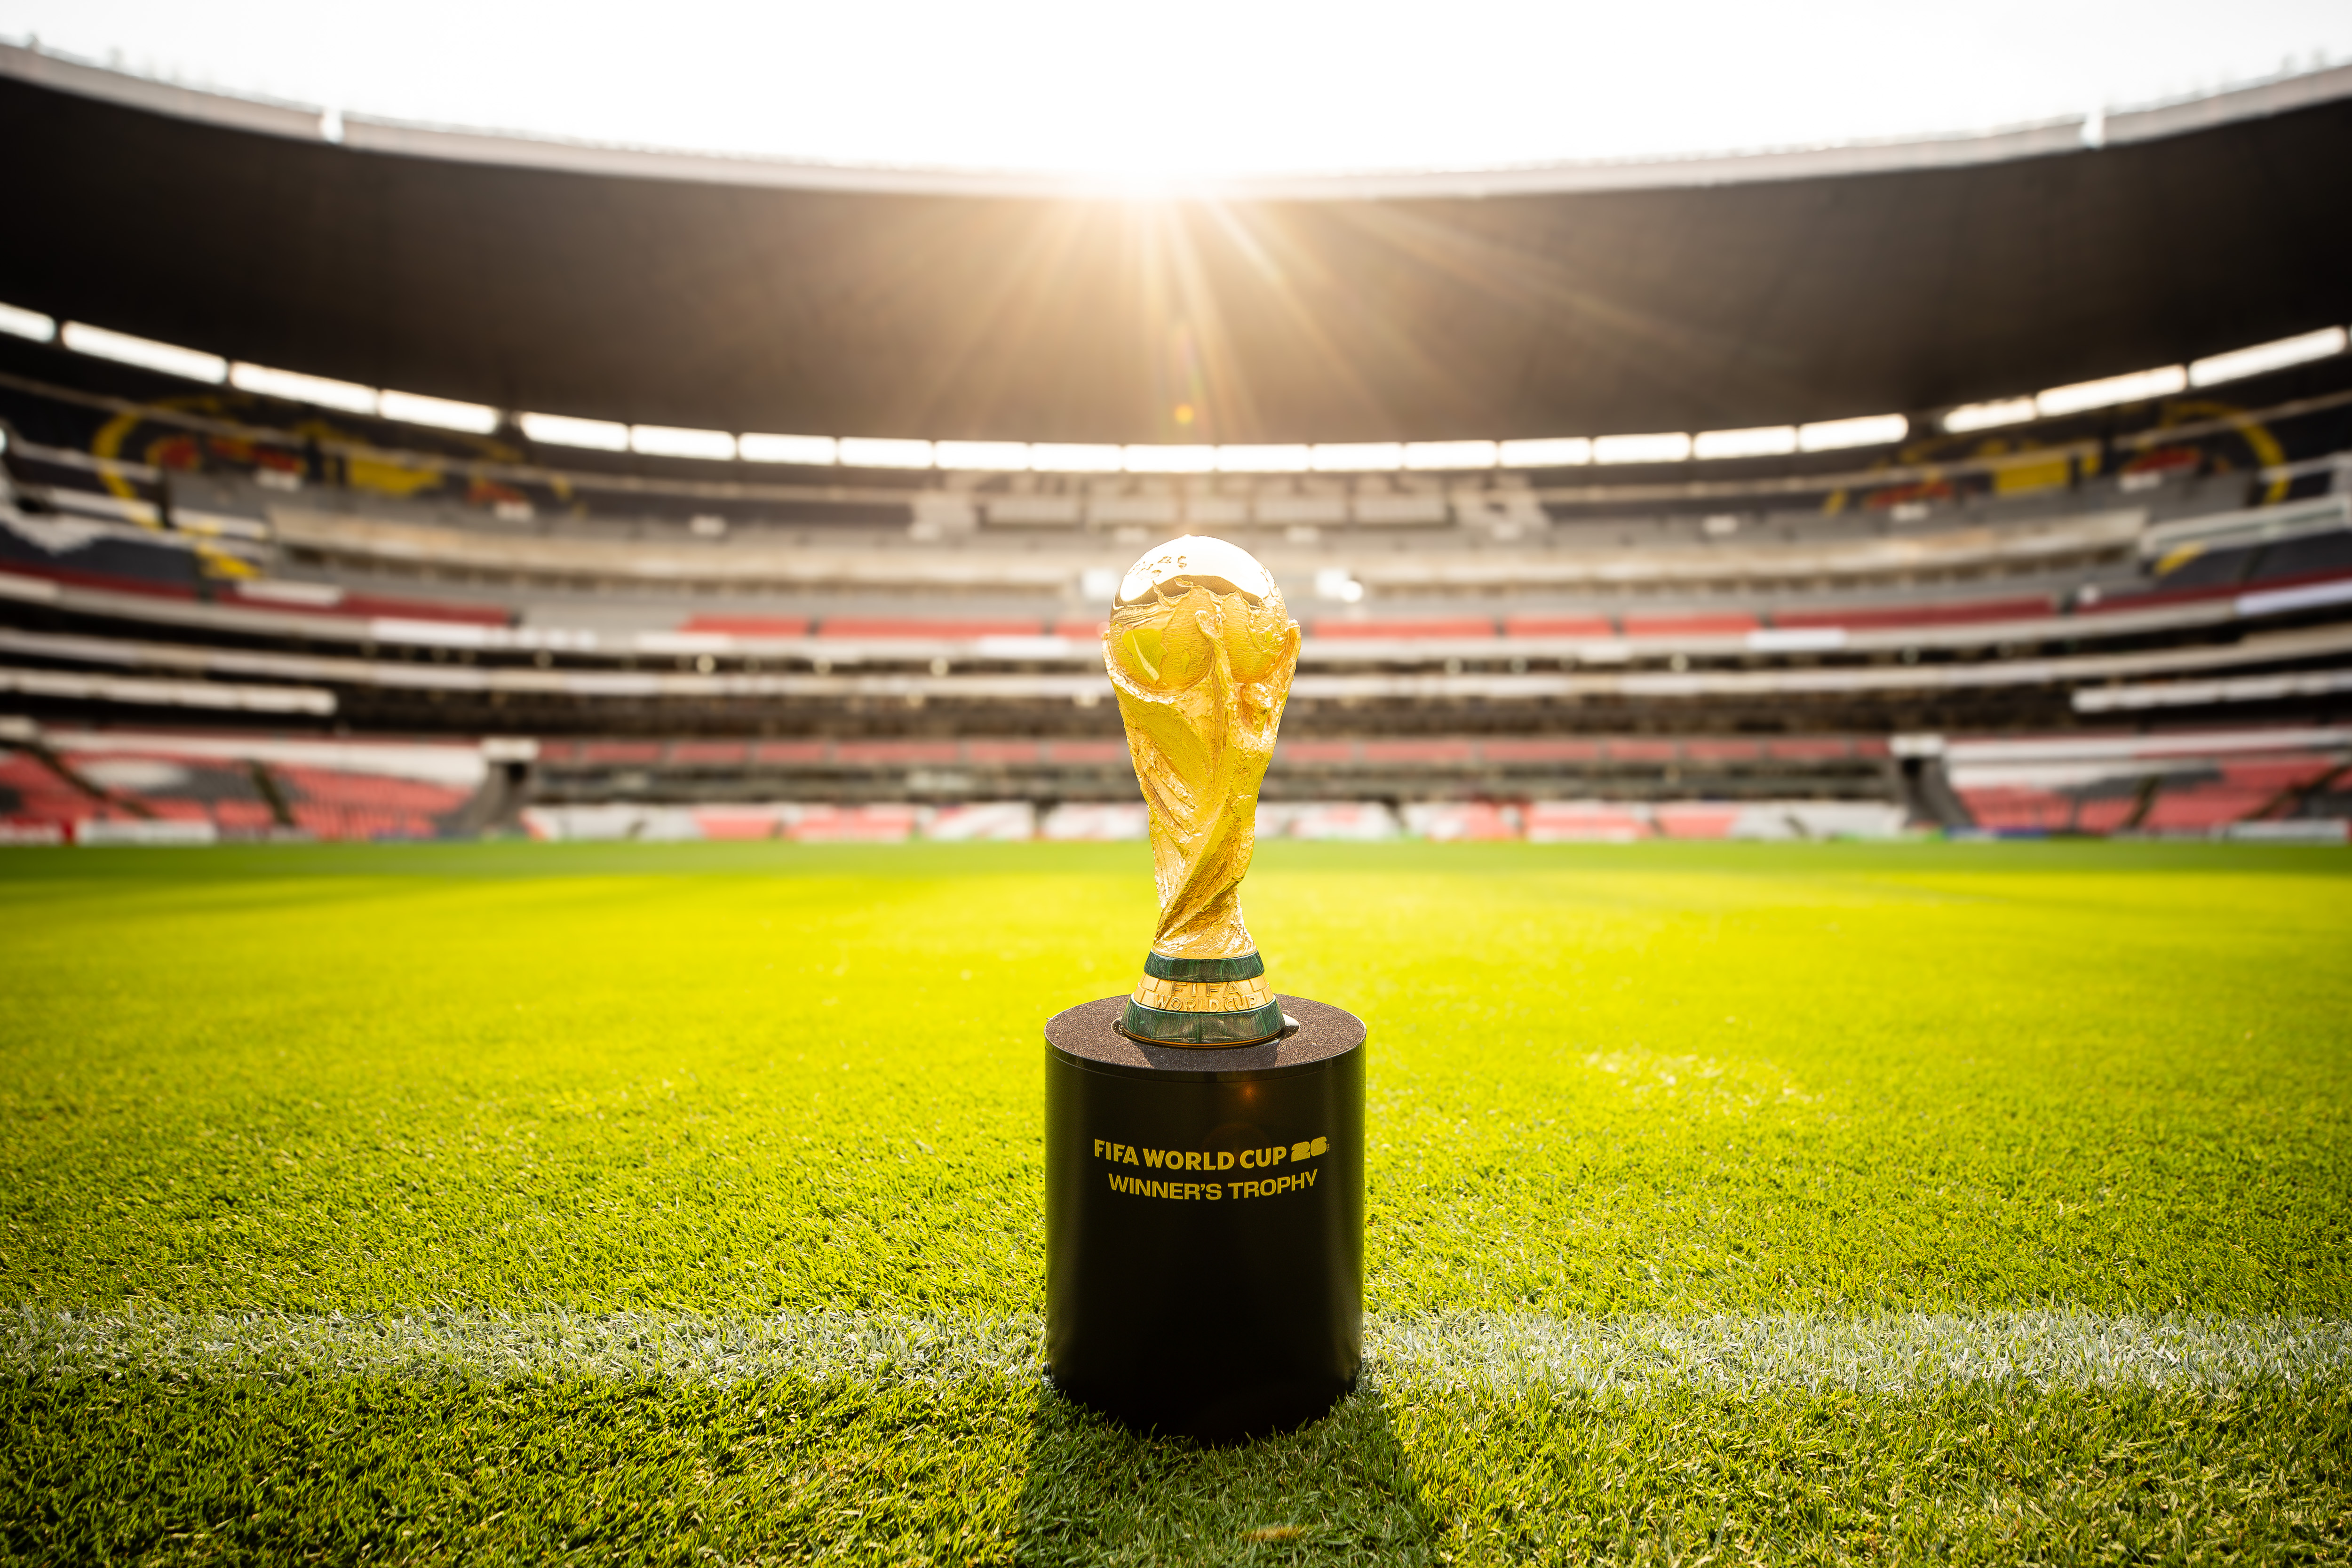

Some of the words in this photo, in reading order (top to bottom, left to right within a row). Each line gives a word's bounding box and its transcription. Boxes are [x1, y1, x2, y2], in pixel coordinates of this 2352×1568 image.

[1170, 981, 1244, 998] FIFA
[1154, 993, 1221, 1012] WORLD
[1224, 994, 1257, 1011] CUP
[1094, 1138, 1139, 1166] FIFA
[1143, 1148, 1235, 1170] WORLD
[1240, 1146, 1287, 1169] CUP
[1108, 1173, 1222, 1200] WINNER’S
[1228, 1168, 1318, 1199] TROPHY
